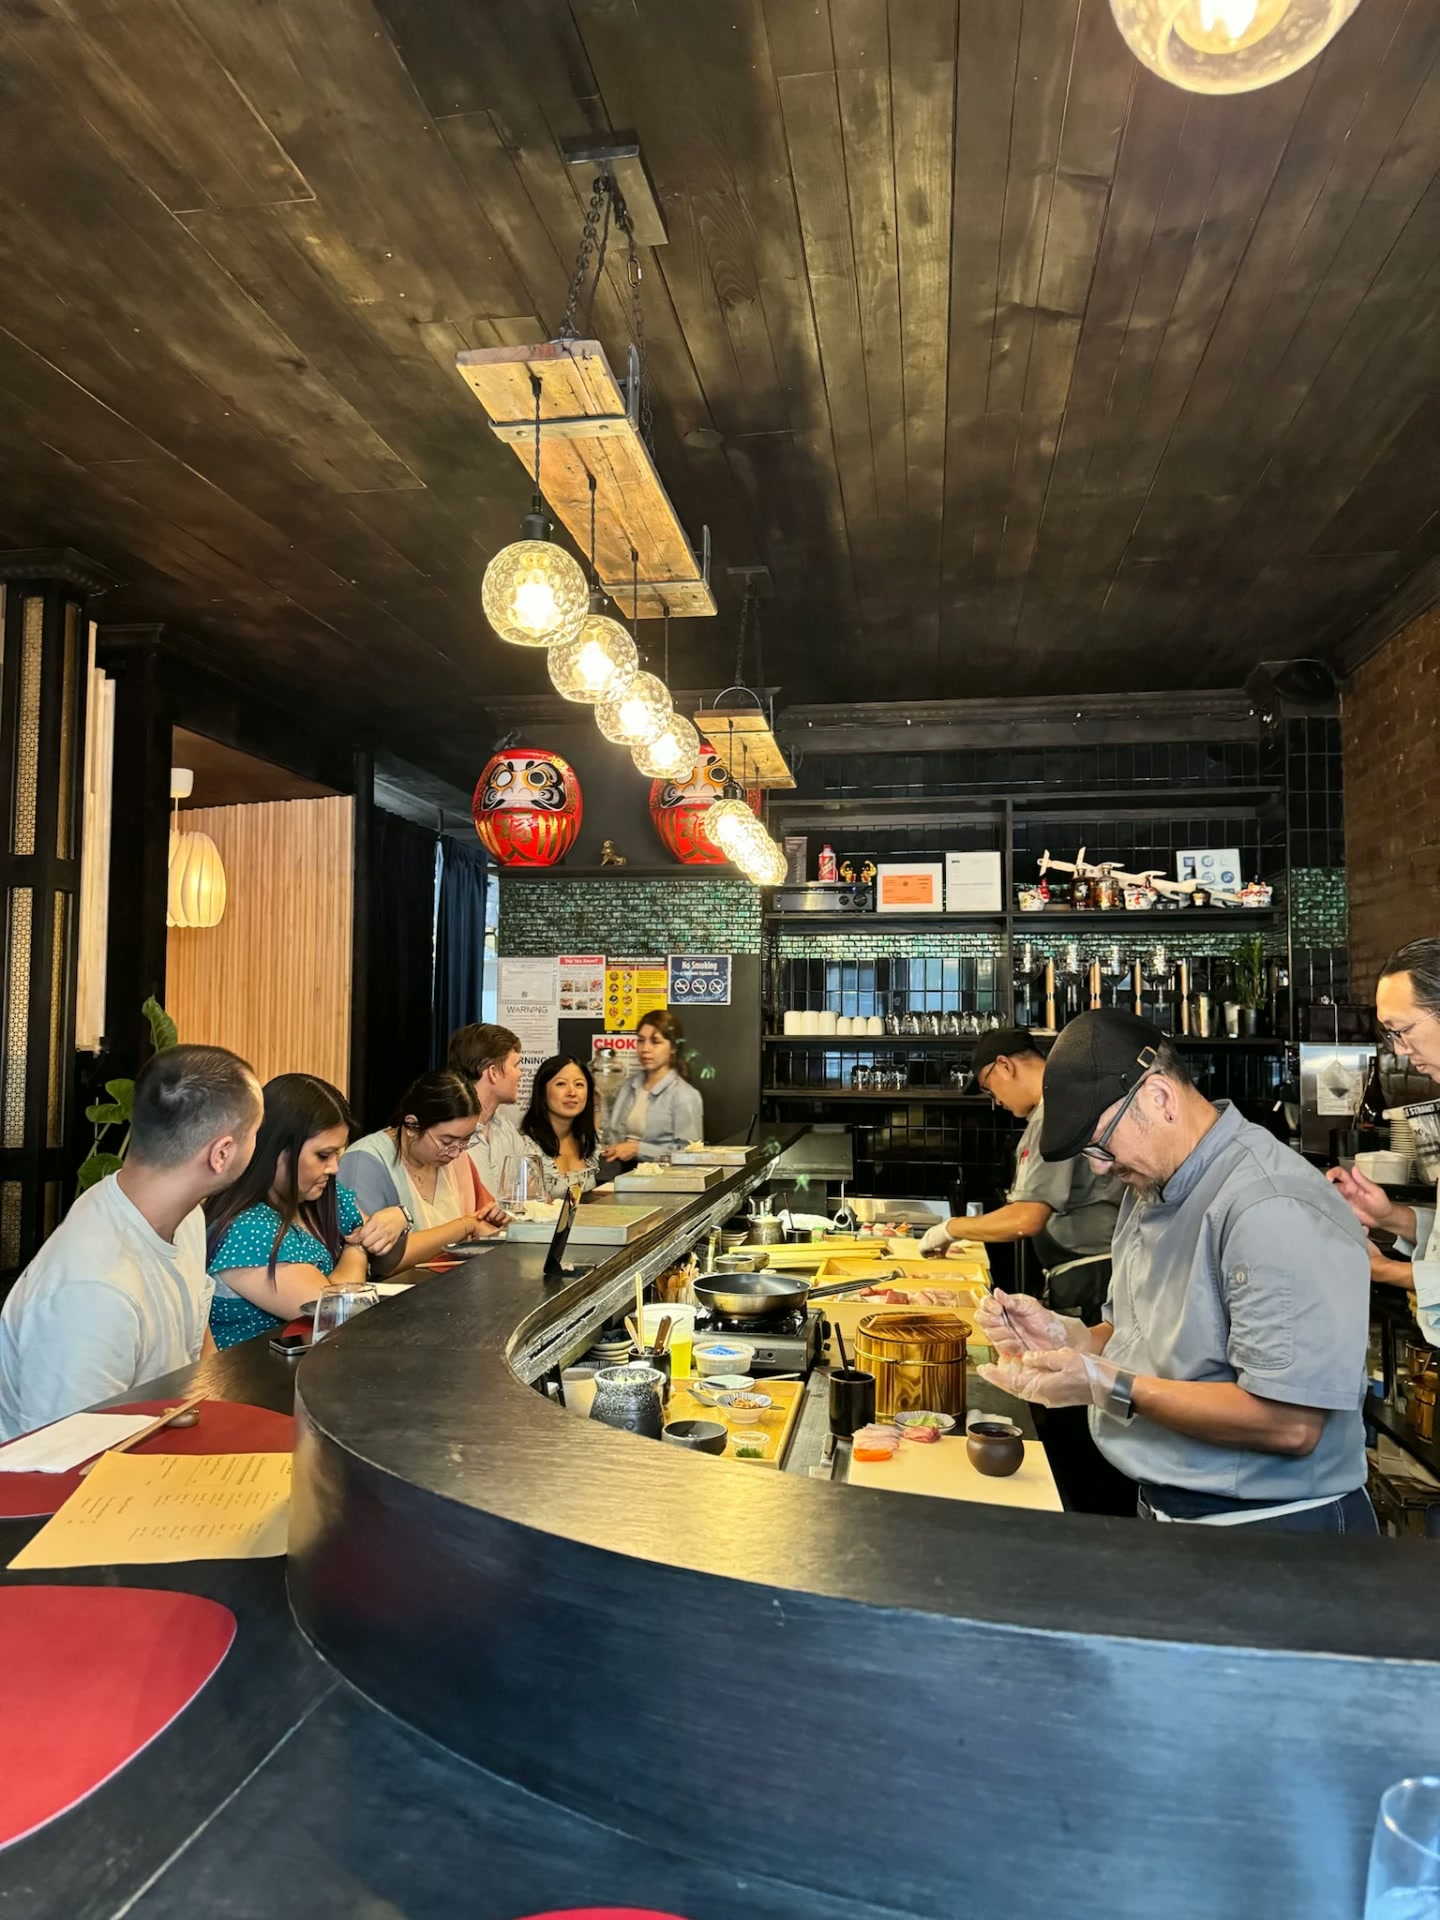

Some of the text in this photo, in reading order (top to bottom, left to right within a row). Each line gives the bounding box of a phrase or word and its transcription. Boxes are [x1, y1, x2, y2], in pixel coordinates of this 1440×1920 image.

[681, 960, 718, 971] No Smoking
[506, 1005, 548, 1014] WARNING
[593, 1038, 636, 1050] CHOK
